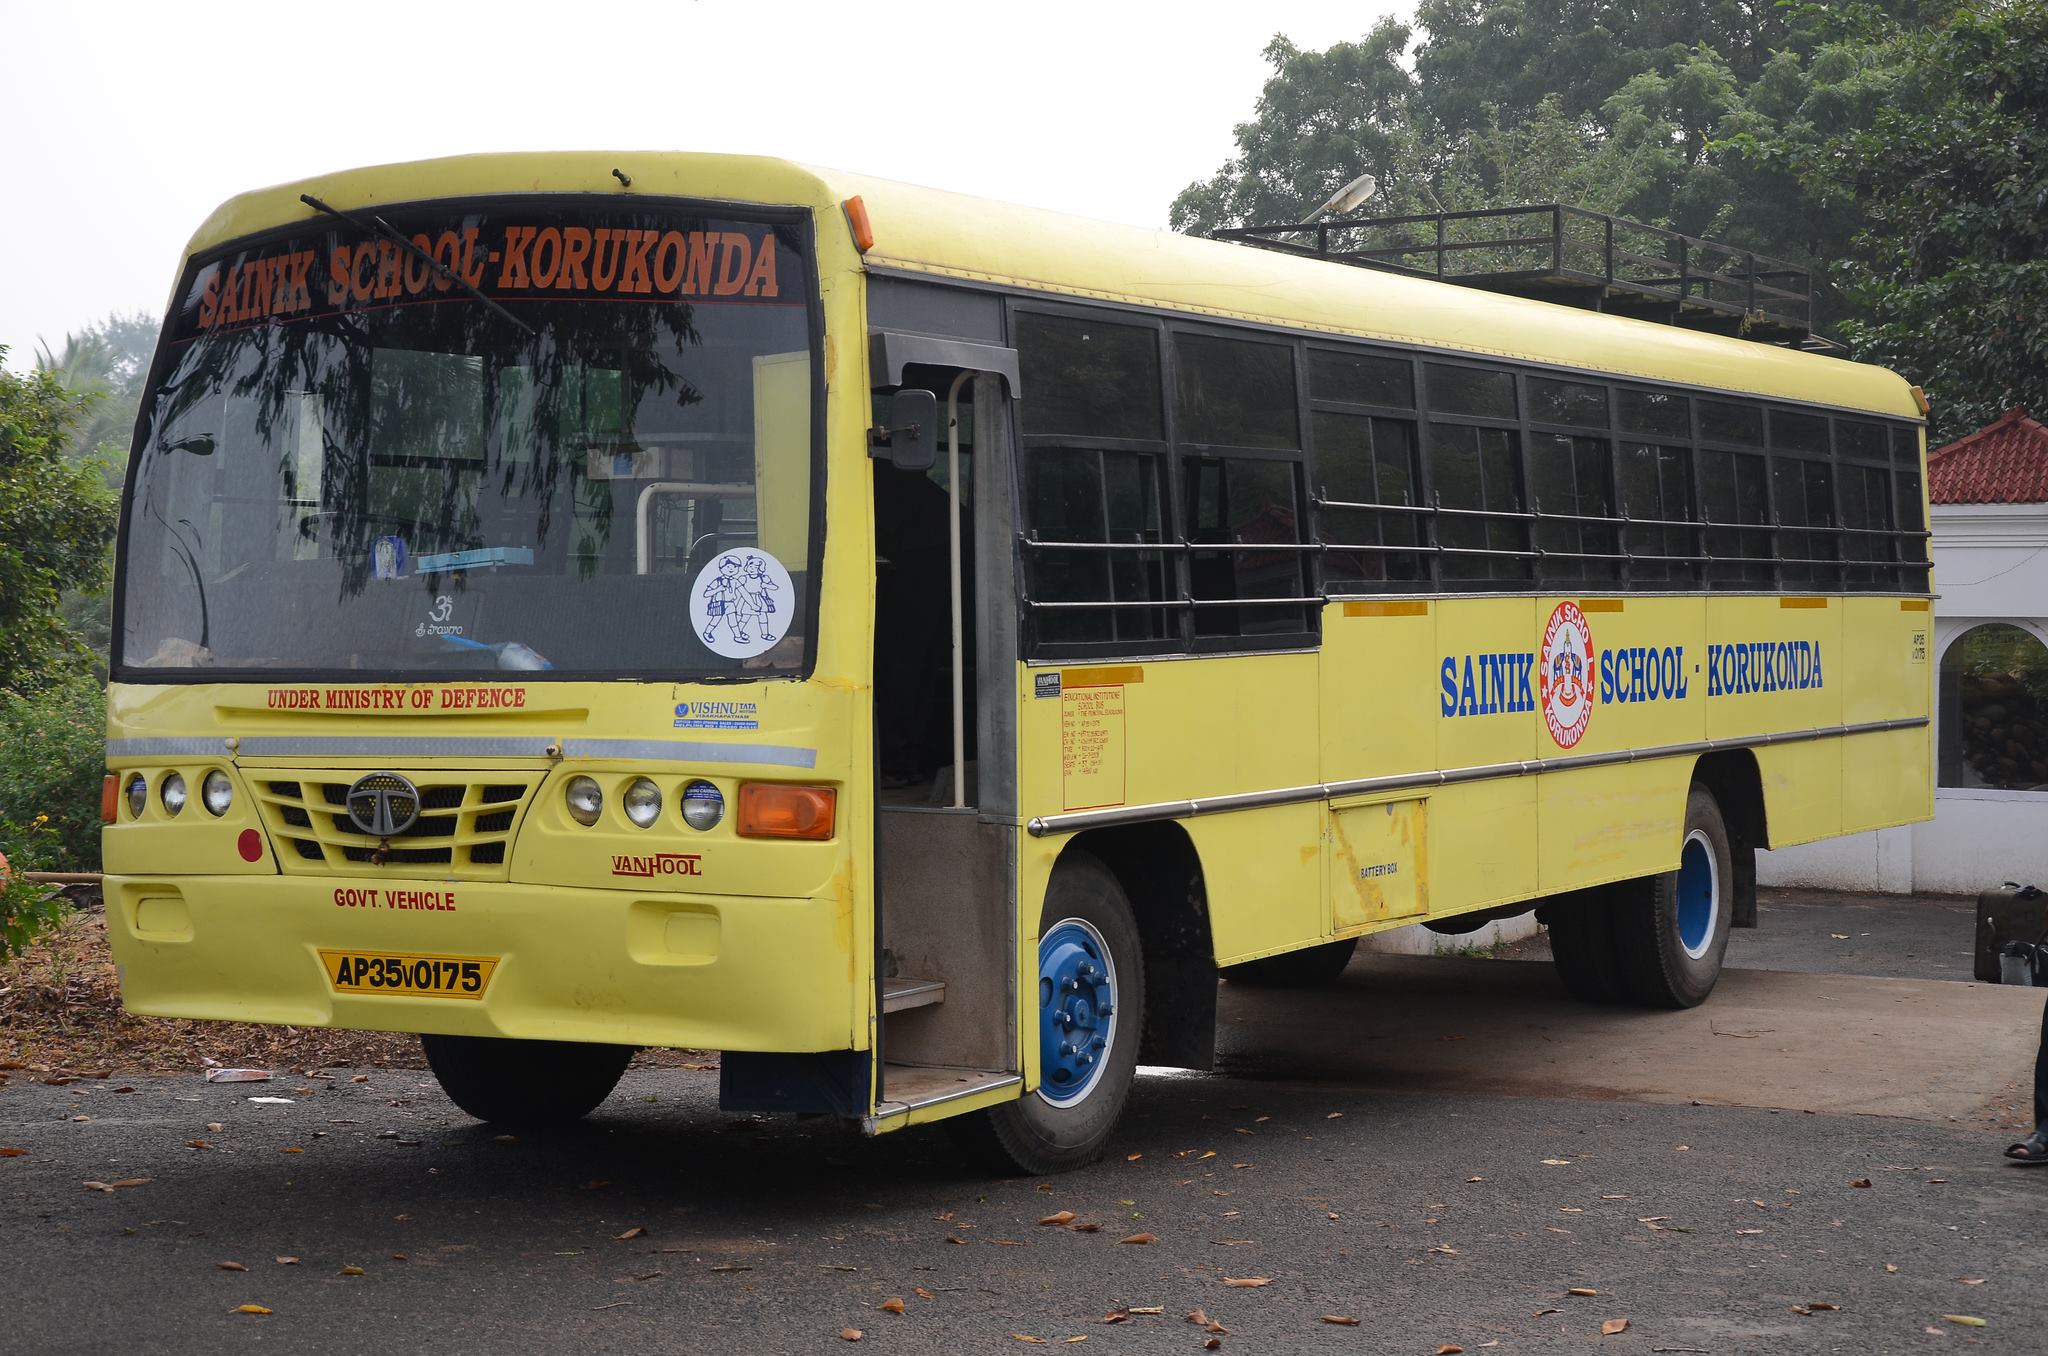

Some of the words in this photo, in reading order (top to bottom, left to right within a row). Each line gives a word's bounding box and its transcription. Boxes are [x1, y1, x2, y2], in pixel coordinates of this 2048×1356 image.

[196, 250, 314, 329] SAINIK
[1541, 607, 1564, 677] SAINIK
[1440, 653, 1536, 718] SAINIK
[1601, 646, 1688, 705] SCHOOL
[1707, 640, 1823, 697] KORUKONDA
[268, 689, 320, 708] UNDER
[325, 689, 406, 709] MINISTRY
[411, 689, 433, 708] OF
[441, 688, 526, 708] DEFENCE
[690, 702, 739, 715] VISHNU
[1545, 701, 1593, 747] KORUKONDA
[1361, 865, 1387, 879] BATTERY
[1387, 862, 1398, 875] BOX
[334, 888, 382, 908] GOVT.
[385, 890, 457, 911] VEHICLE
[336, 957, 482, 992] AP35V0175
